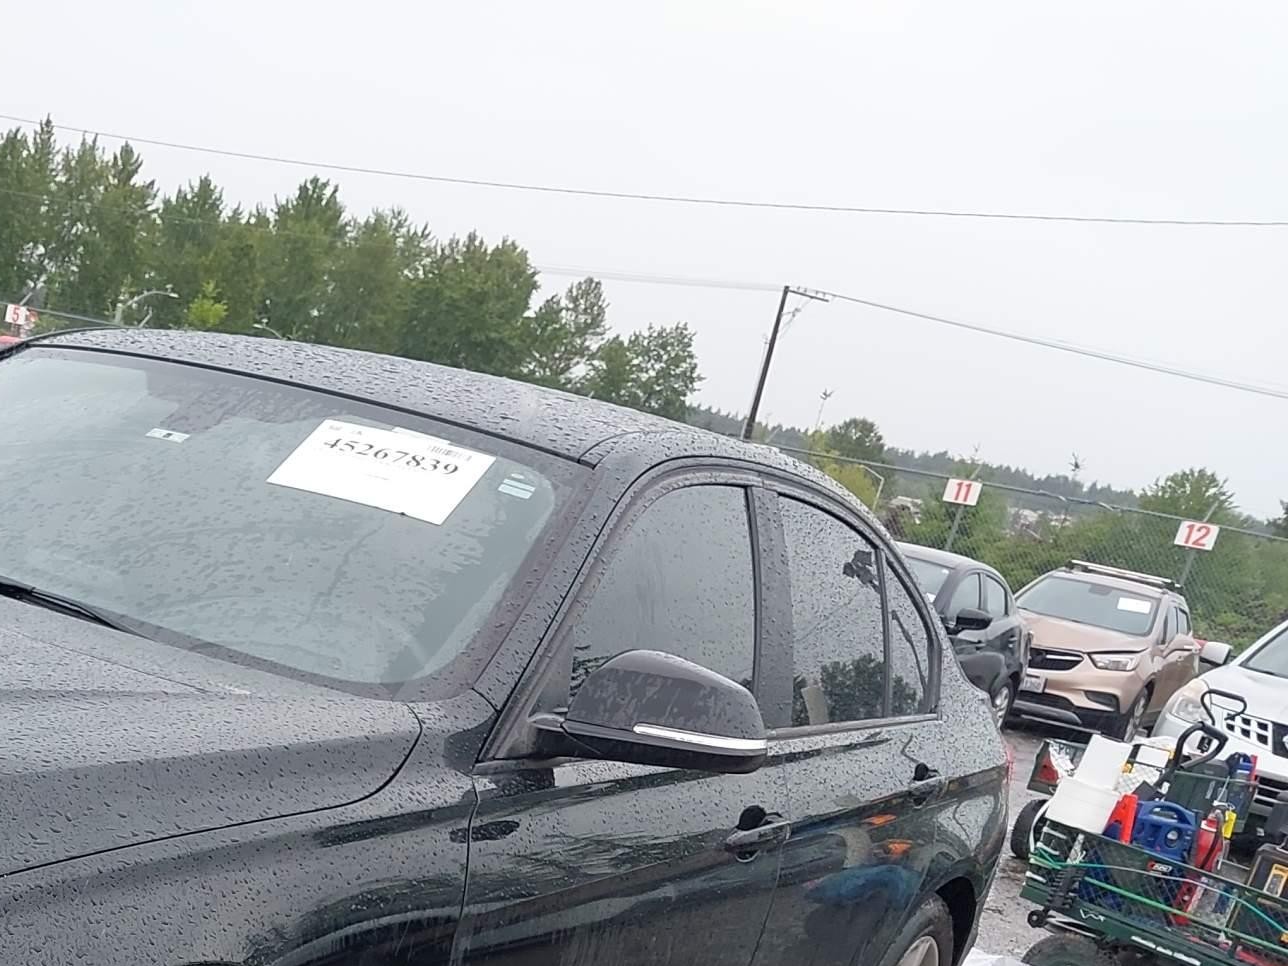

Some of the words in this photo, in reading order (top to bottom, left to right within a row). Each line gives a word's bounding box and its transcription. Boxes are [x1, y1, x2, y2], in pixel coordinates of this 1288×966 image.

[11, 306, 20, 323] 5
[324, 437, 459, 476] 45267839
[952, 481, 974, 503] 11
[1184, 523, 1211, 548] 12
